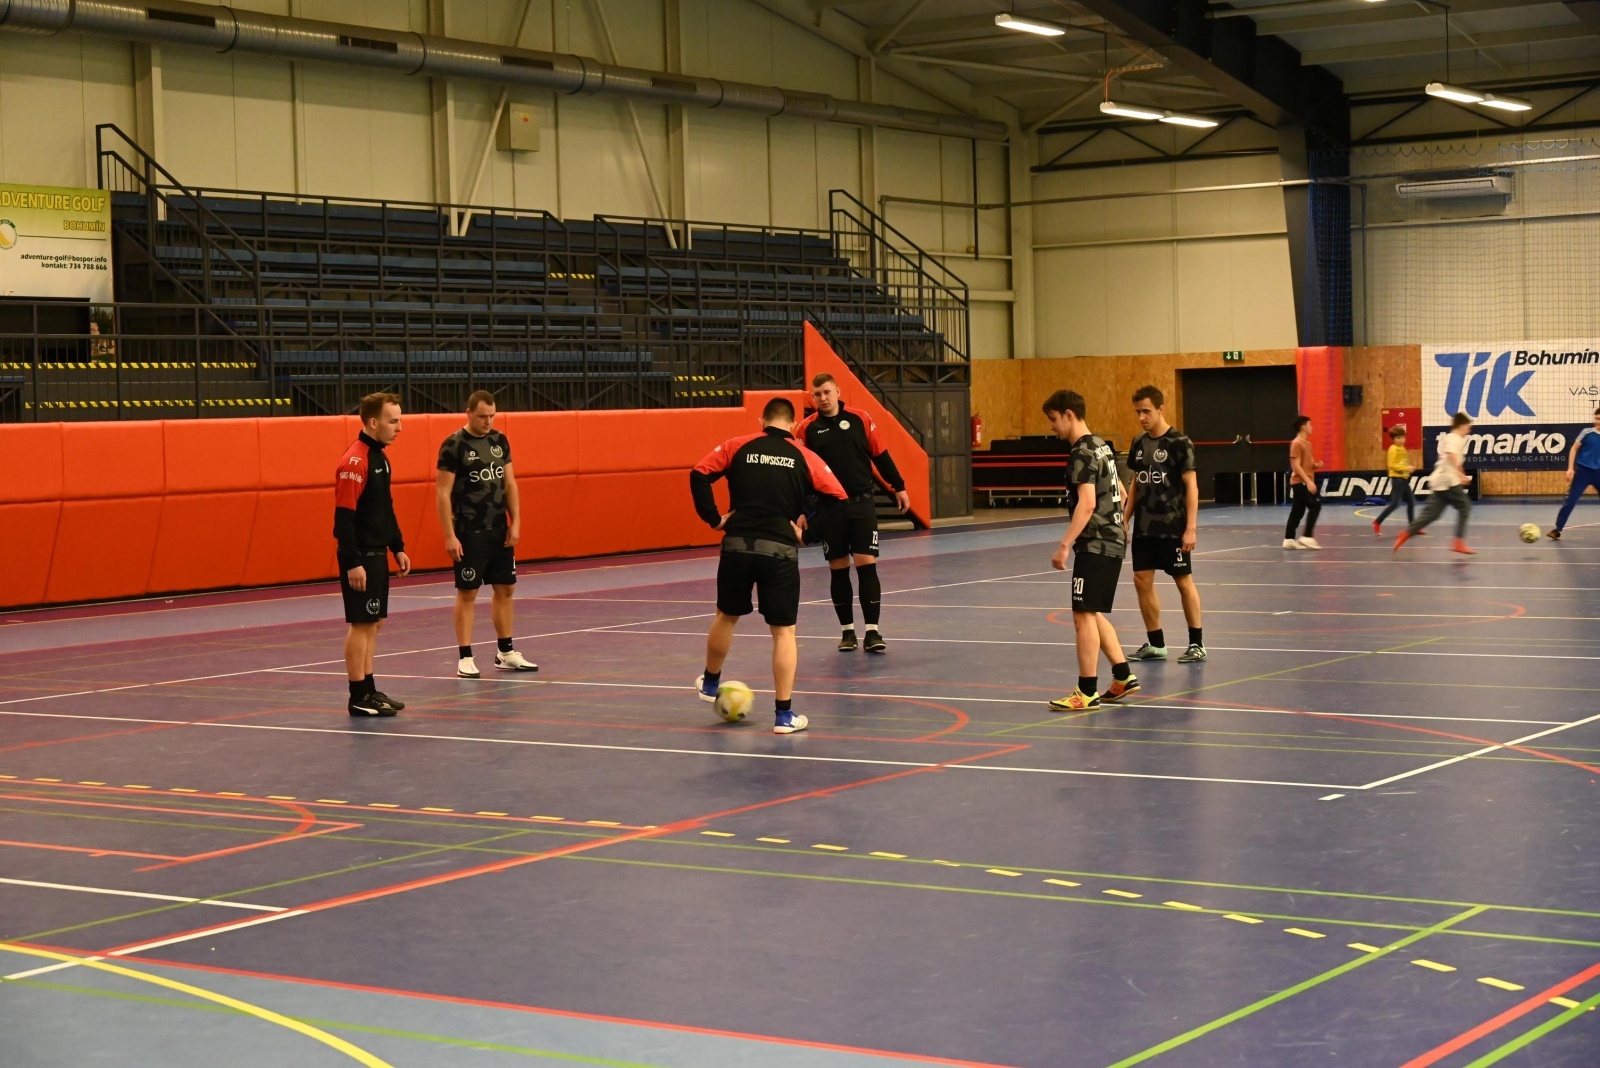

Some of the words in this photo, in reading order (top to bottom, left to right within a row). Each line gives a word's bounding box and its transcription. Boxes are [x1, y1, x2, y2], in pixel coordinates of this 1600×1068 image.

[0, 191, 70, 211] DVENTURE
[72, 195, 105, 212] GOLF
[1514, 349, 1600, 366] Bohumín
[1435, 430, 1566, 455] tmarko
[746, 453, 759, 464] LKS
[760, 454, 796, 468] OWSISZCZE
[469, 461, 505, 483] safe
[1176, 547, 1183, 562] 3
[1073, 577, 1084, 595] 20
